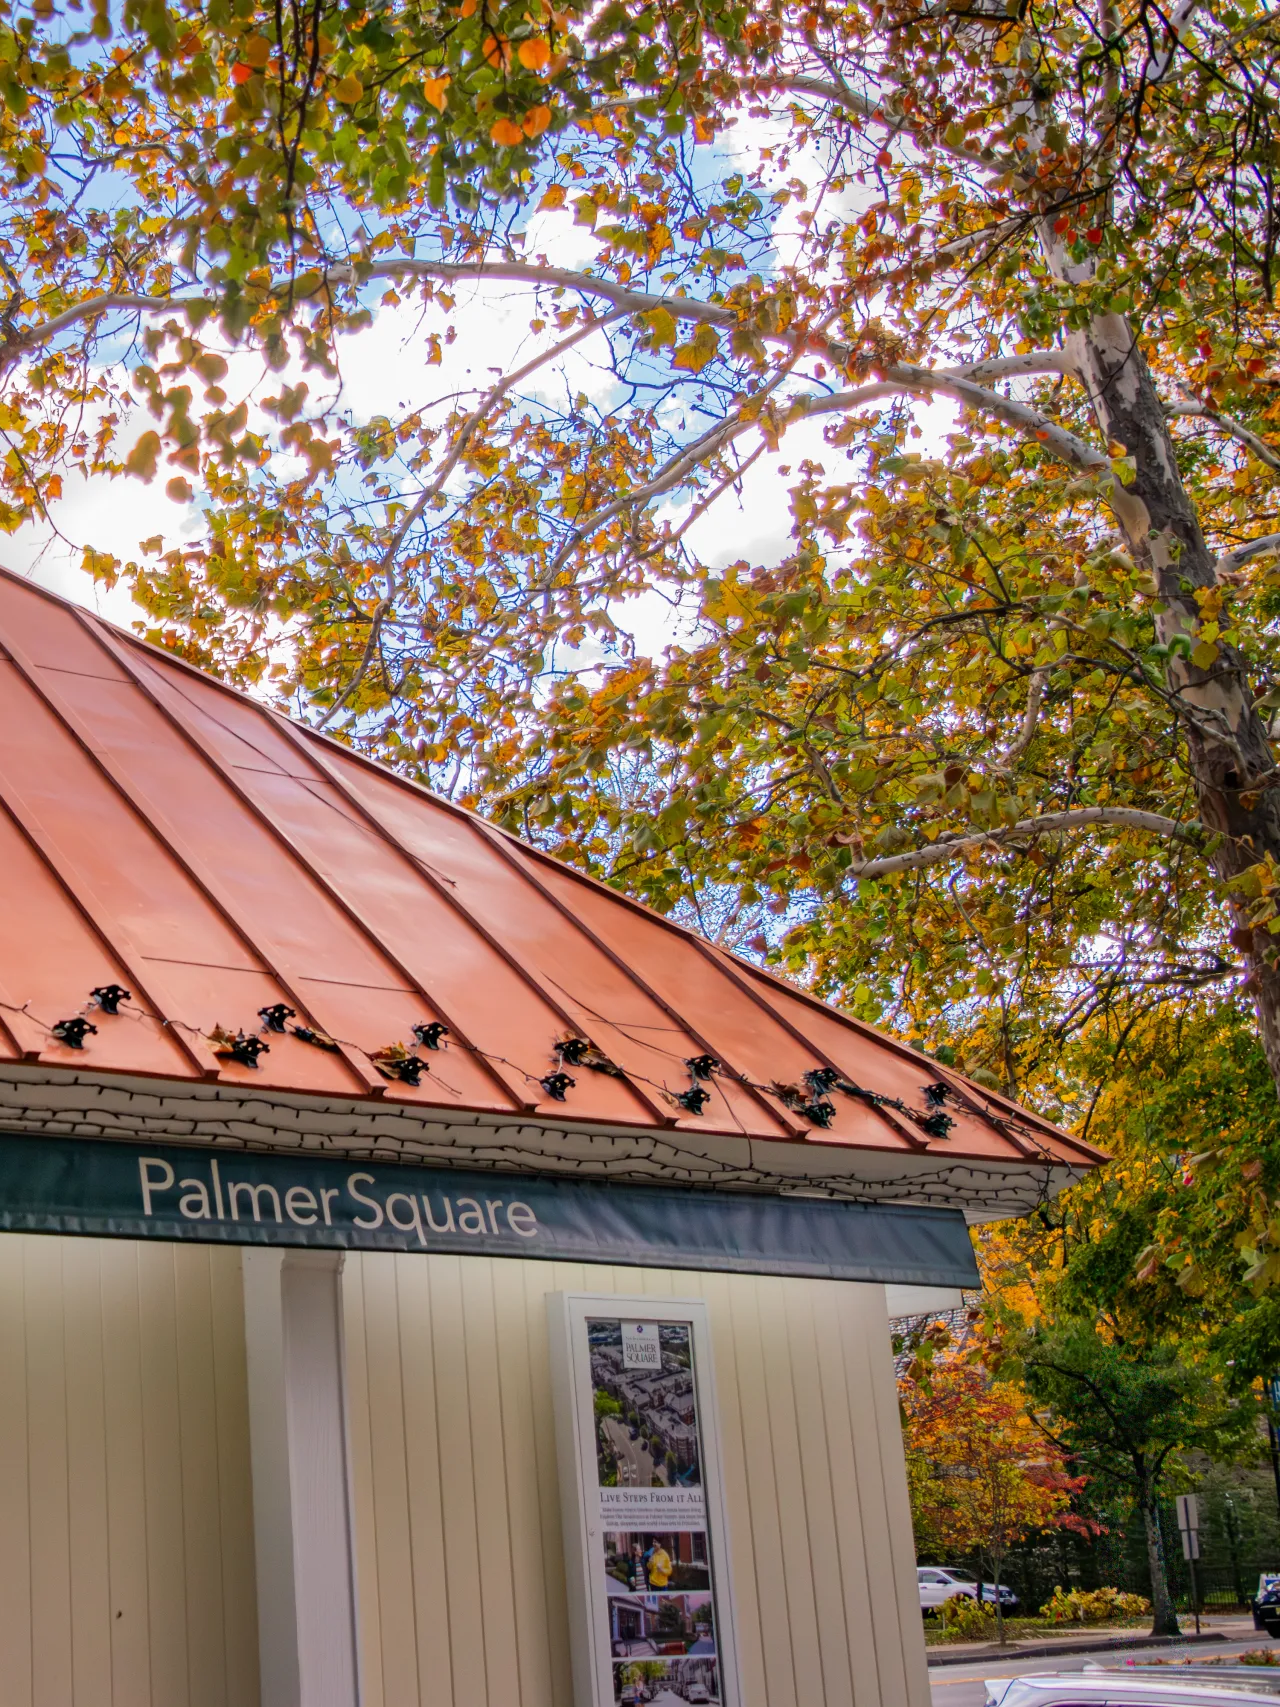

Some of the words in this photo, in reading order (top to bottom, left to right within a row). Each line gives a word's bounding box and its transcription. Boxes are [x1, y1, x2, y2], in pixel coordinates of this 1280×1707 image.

[137, 1155, 339, 1227] Palmer
[346, 1171, 538, 1247] Square
[626, 1342, 657, 1353] PALMER
[626, 1352, 658, 1363] SQUARE
[600, 1491, 621, 1503] LIVE
